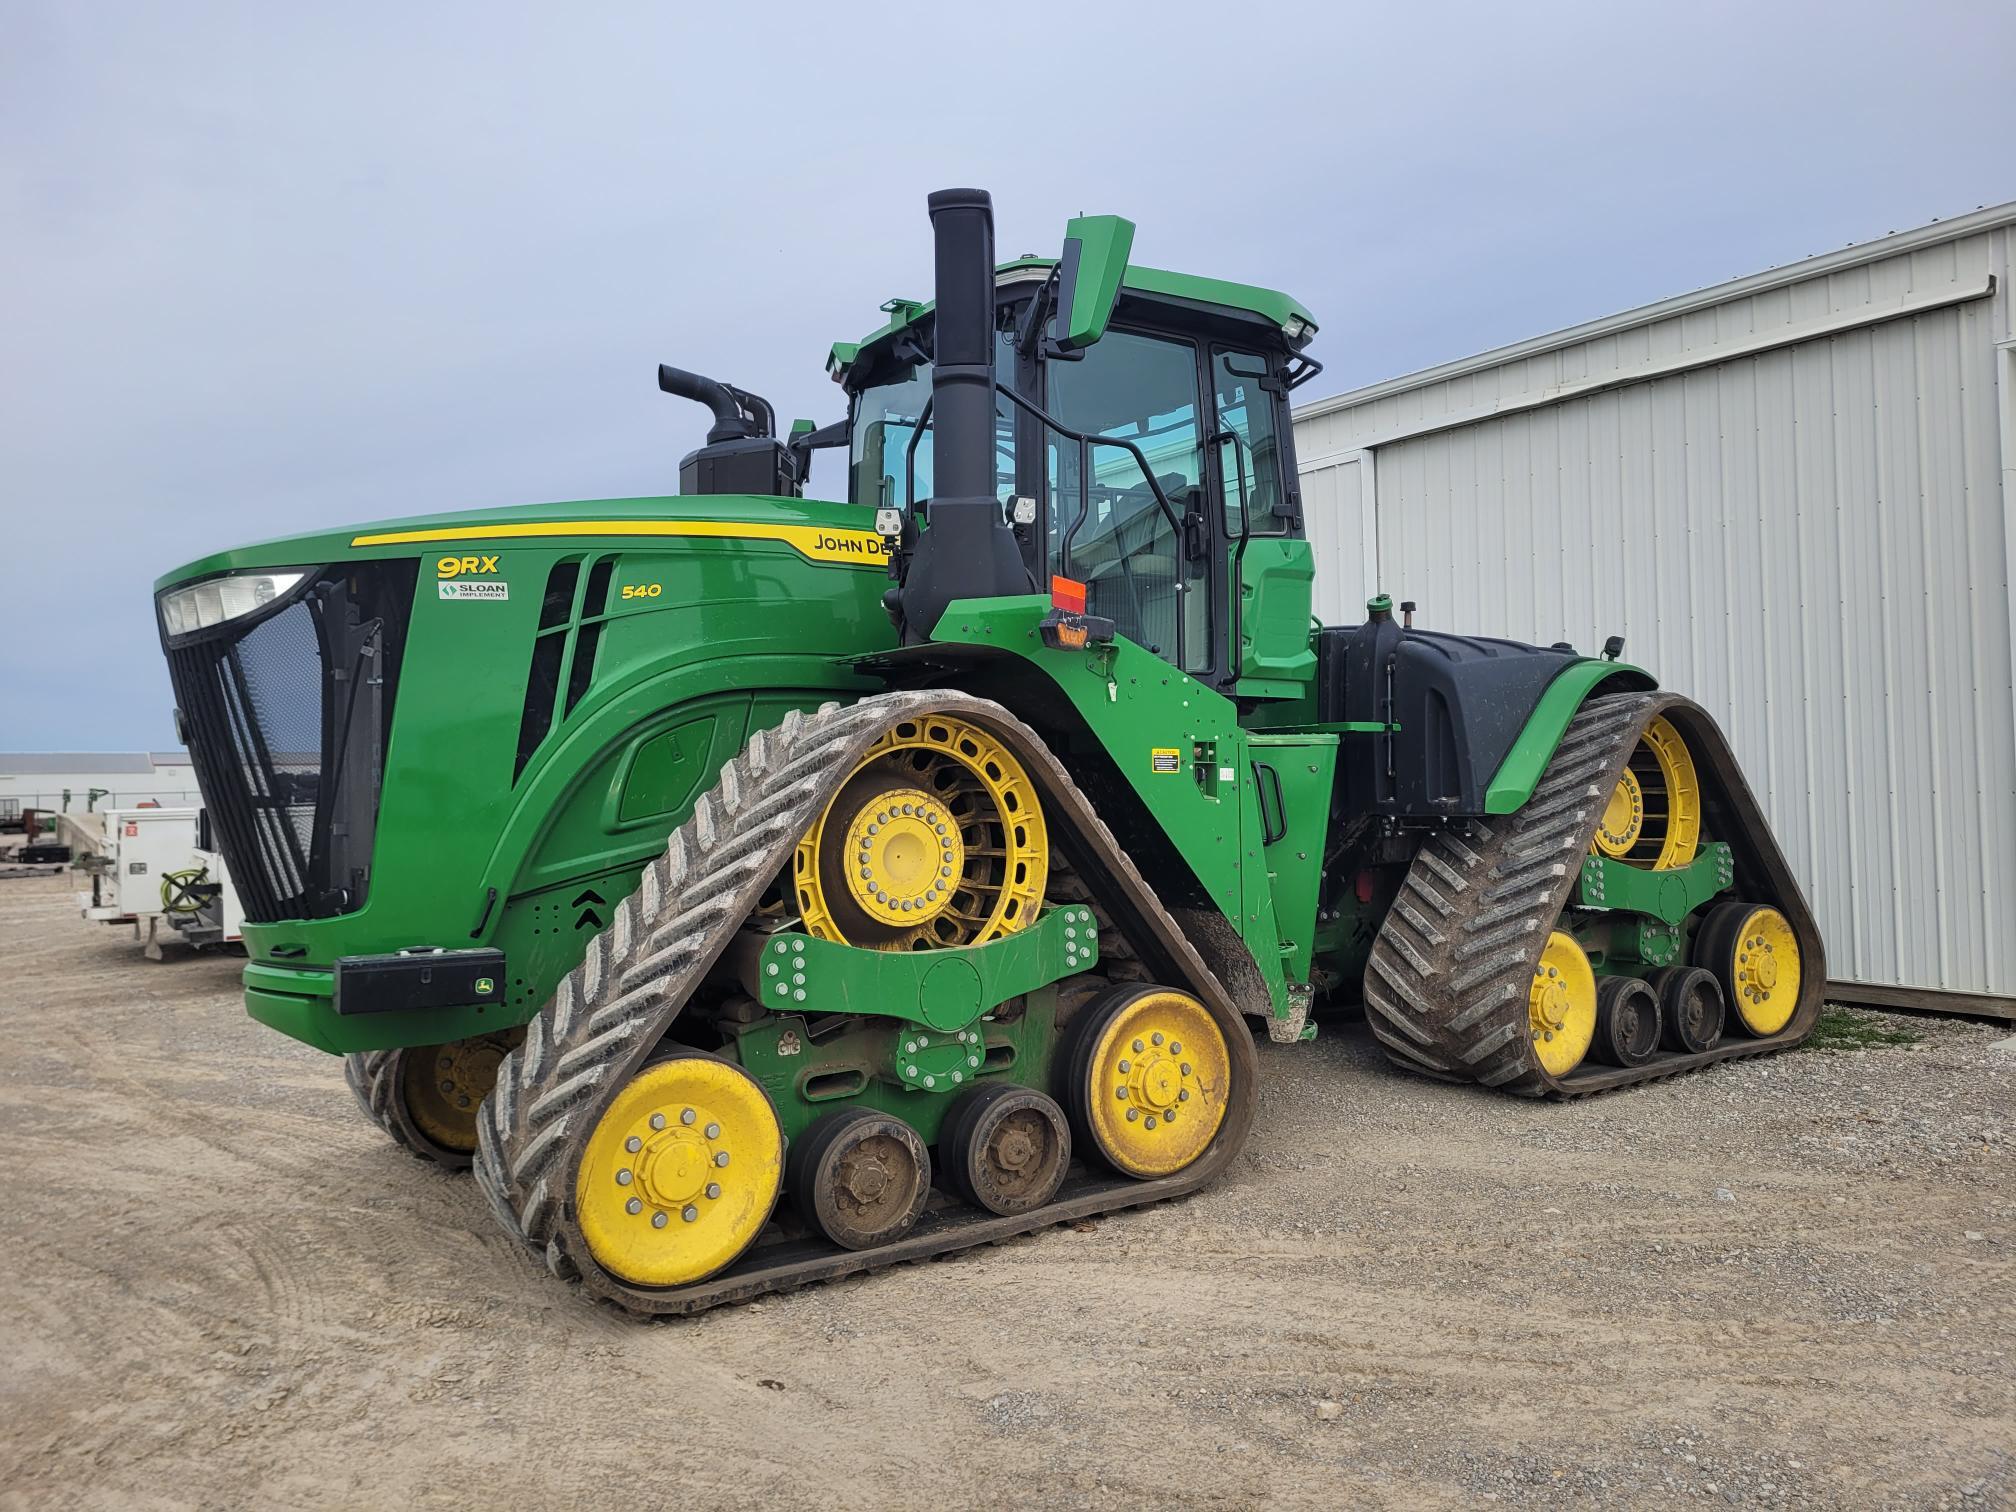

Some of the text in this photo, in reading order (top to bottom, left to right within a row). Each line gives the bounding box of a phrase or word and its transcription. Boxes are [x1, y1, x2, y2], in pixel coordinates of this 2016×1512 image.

[814, 533, 893, 556] JOHN DE
[437, 555, 499, 579] 9RX
[459, 584, 505, 593] SLOAN
[621, 583, 662, 600] 540
